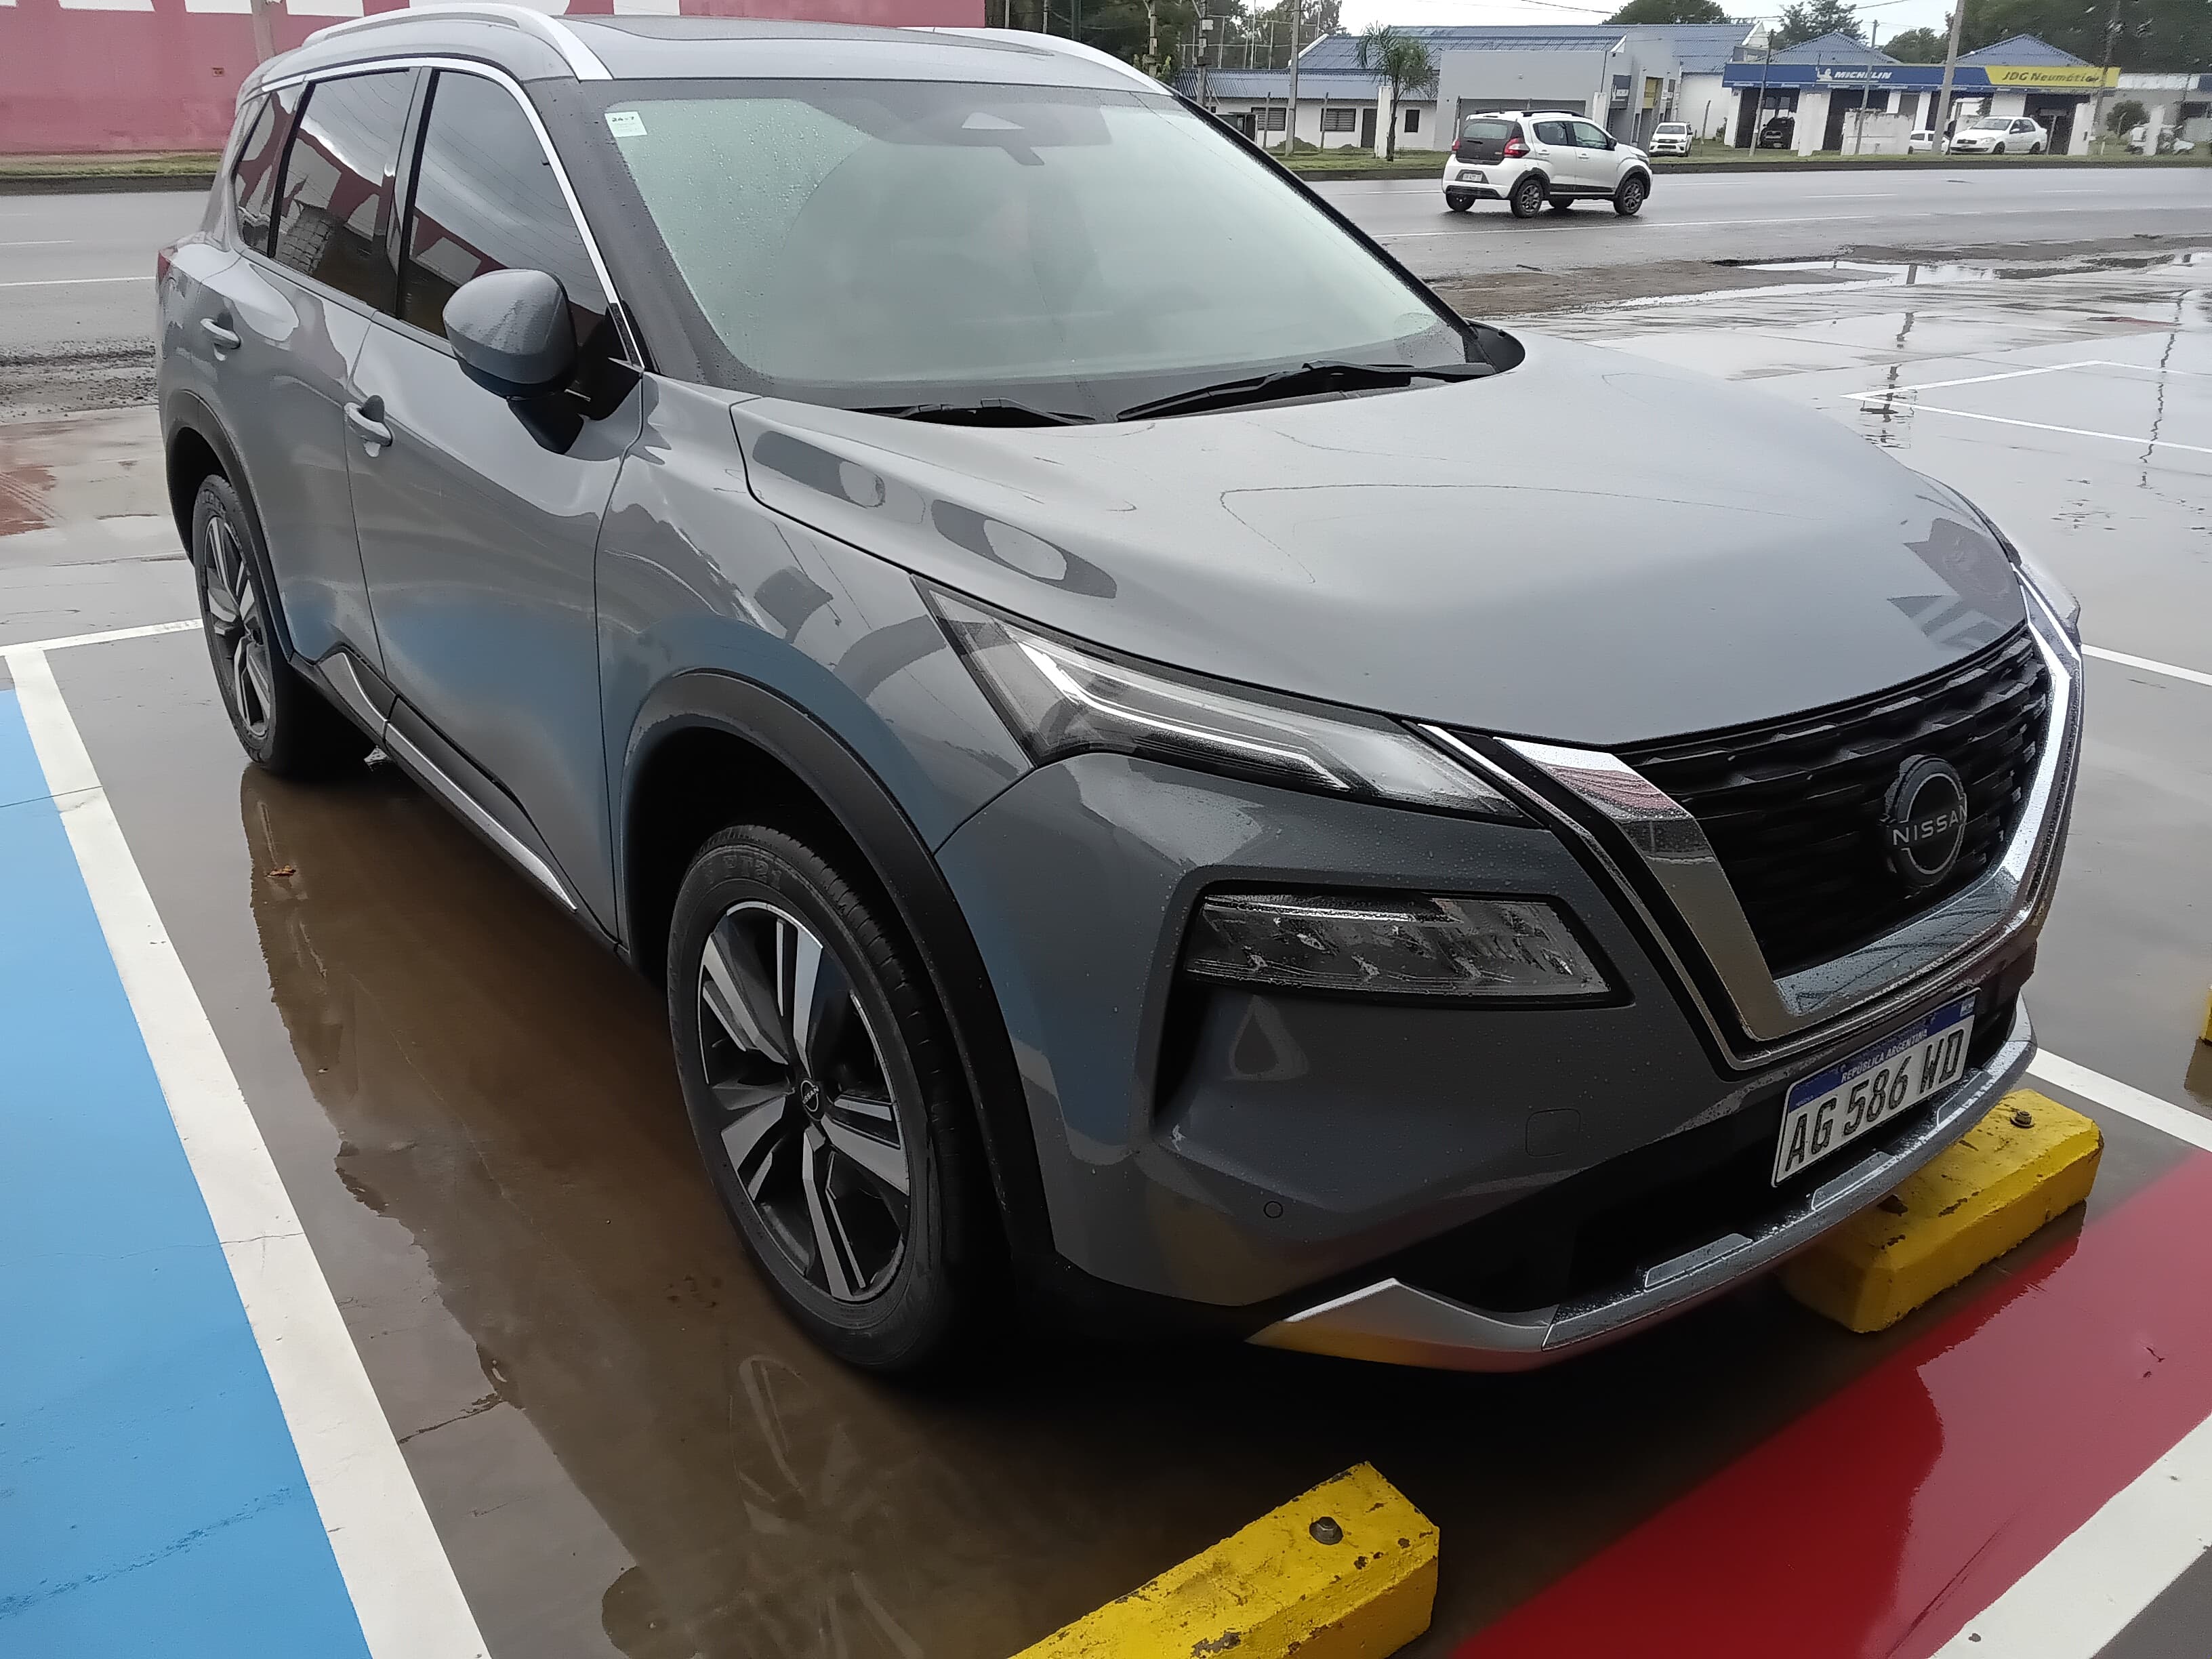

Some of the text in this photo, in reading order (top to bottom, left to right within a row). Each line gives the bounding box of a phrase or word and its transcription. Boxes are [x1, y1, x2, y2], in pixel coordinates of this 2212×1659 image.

[1893, 804, 1967, 846] NISSAN
[1885, 1028, 1927, 1059] ARGENTINA
[1784, 1029, 1965, 1172] AG 586 WD
